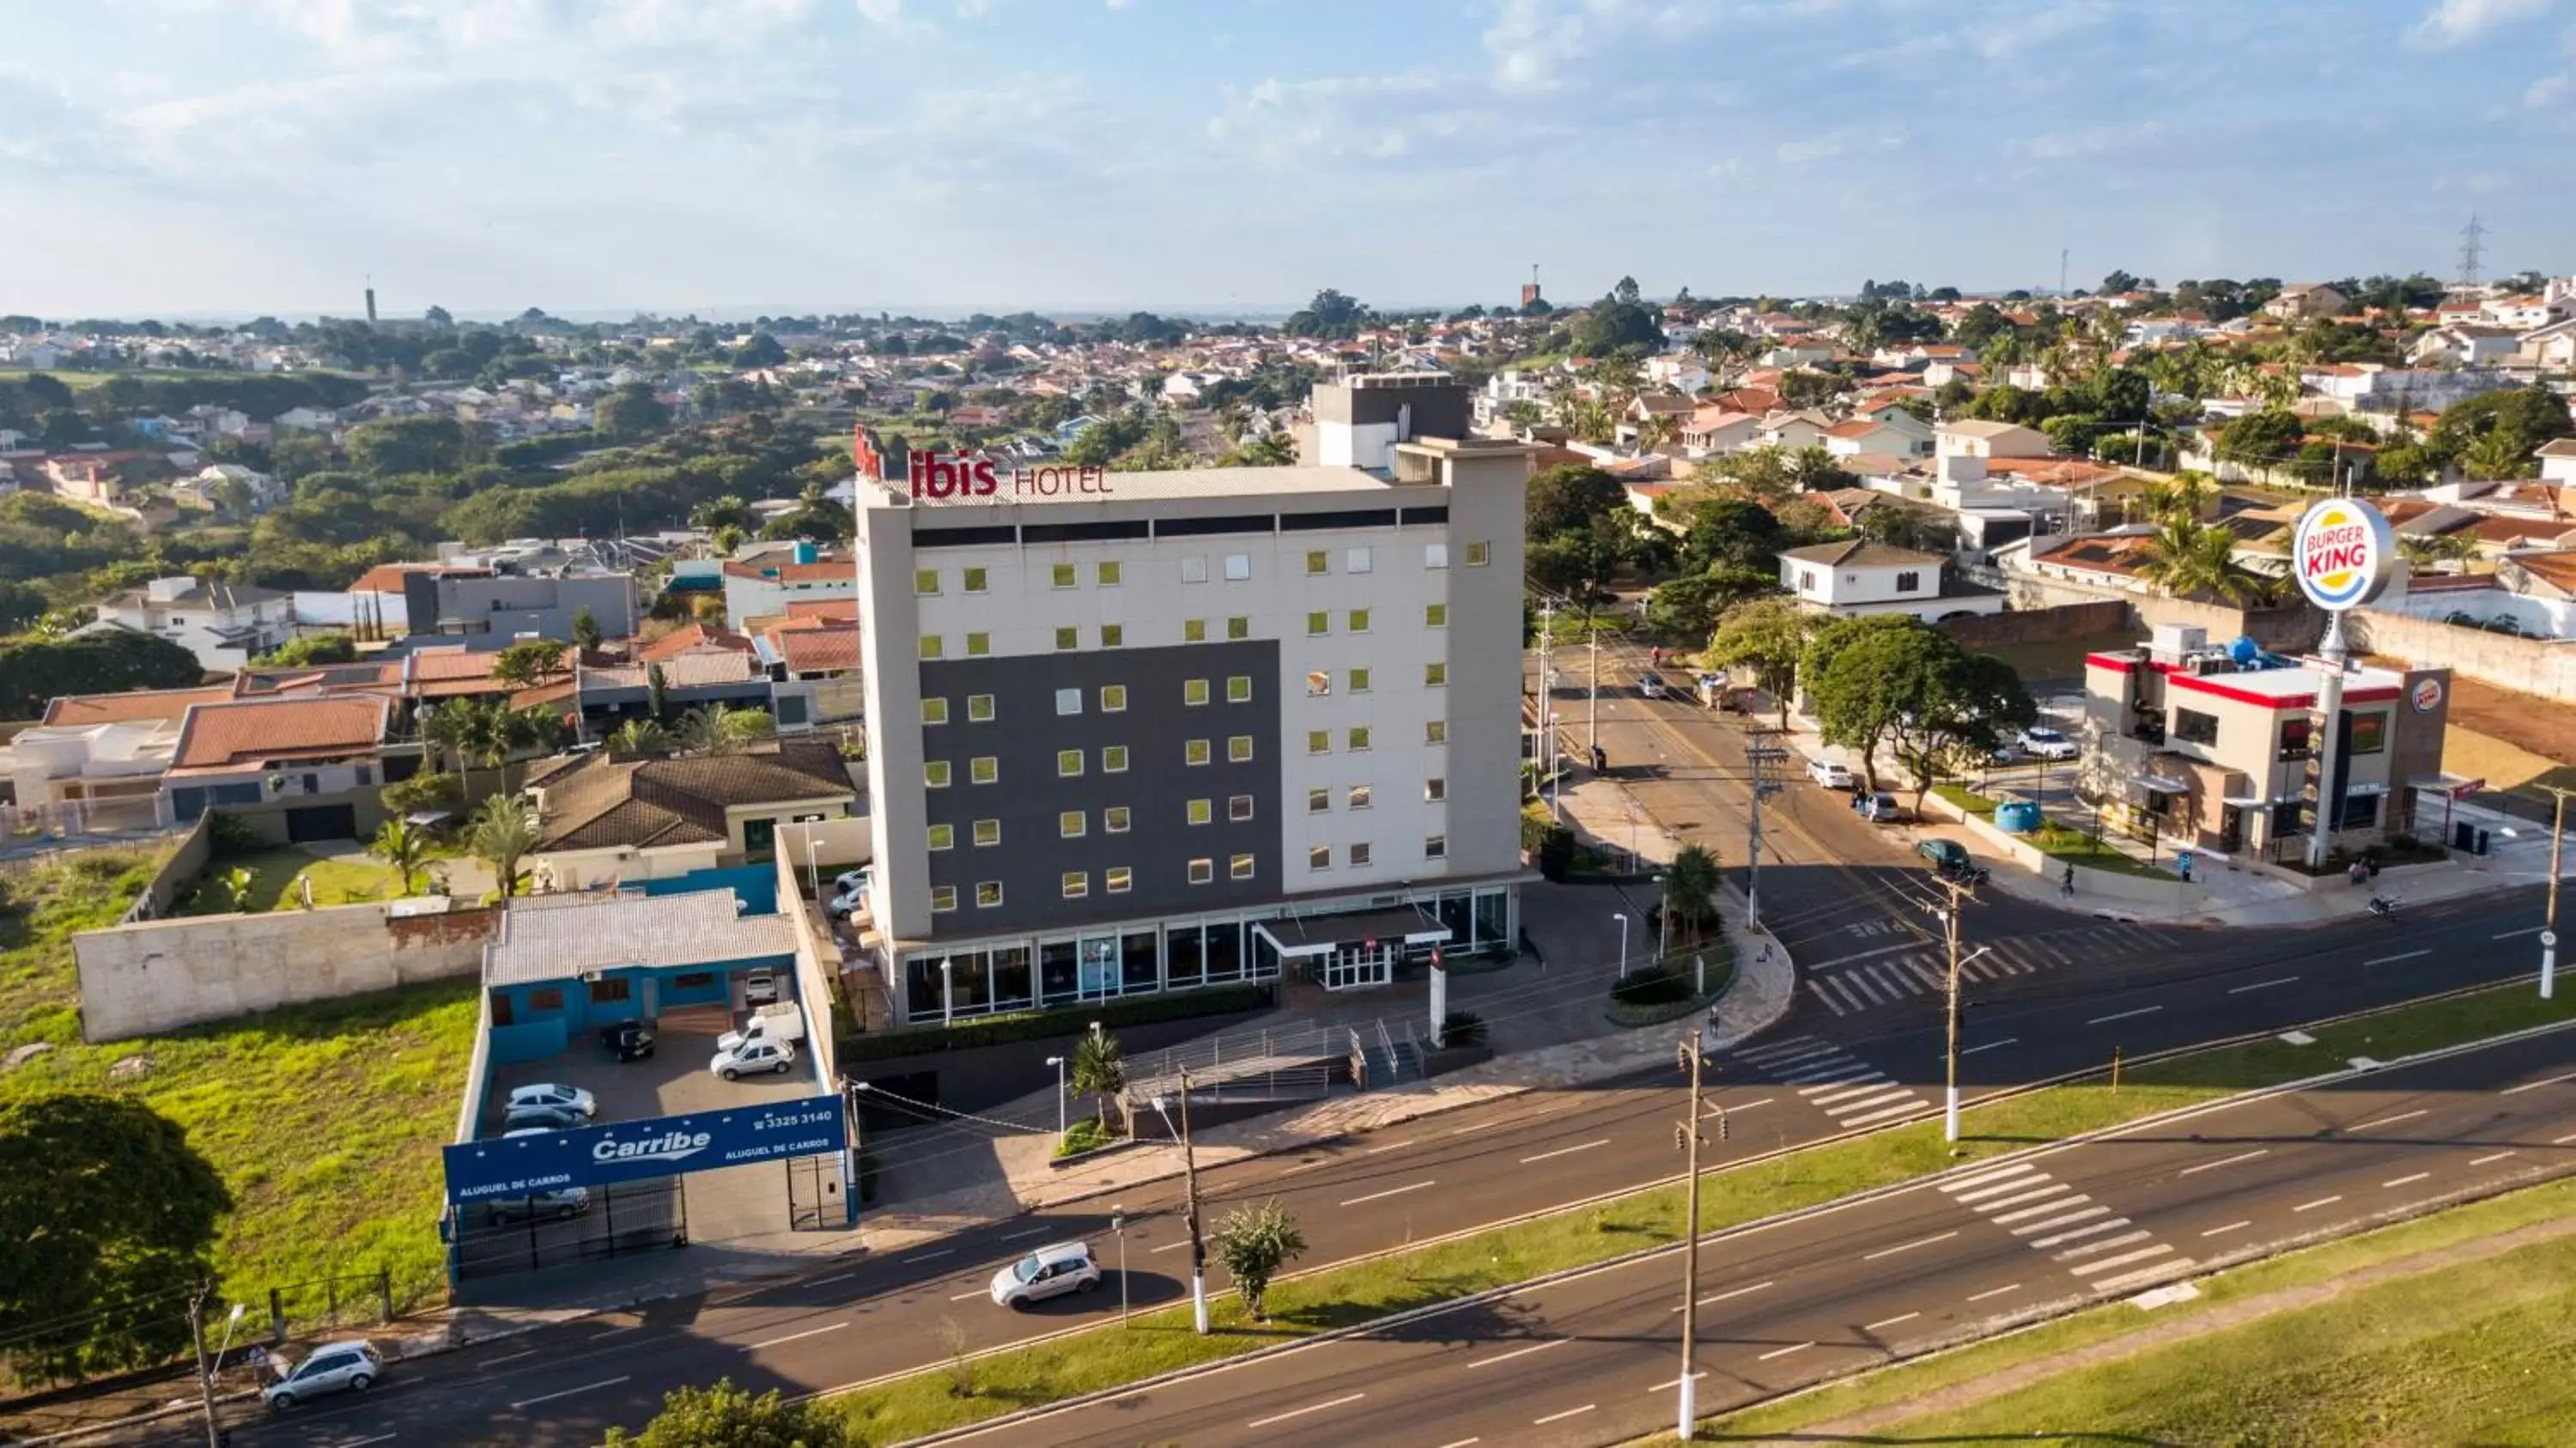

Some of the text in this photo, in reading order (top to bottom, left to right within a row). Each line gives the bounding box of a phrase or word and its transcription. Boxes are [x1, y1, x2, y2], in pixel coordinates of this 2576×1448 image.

[911, 449, 997, 498] ibis
[1015, 465, 1114, 496] HOTEL
[2306, 526, 2365, 551] BURGER
[2307, 544, 2366, 578] KING
[767, 1110, 832, 1129] 3325 3140
[592, 1131, 712, 1160] Carribe
[725, 1138, 829, 1160] ALUGUEL DE CARROS
[459, 1173, 571, 1196] ALUGUEL DE CARROS
